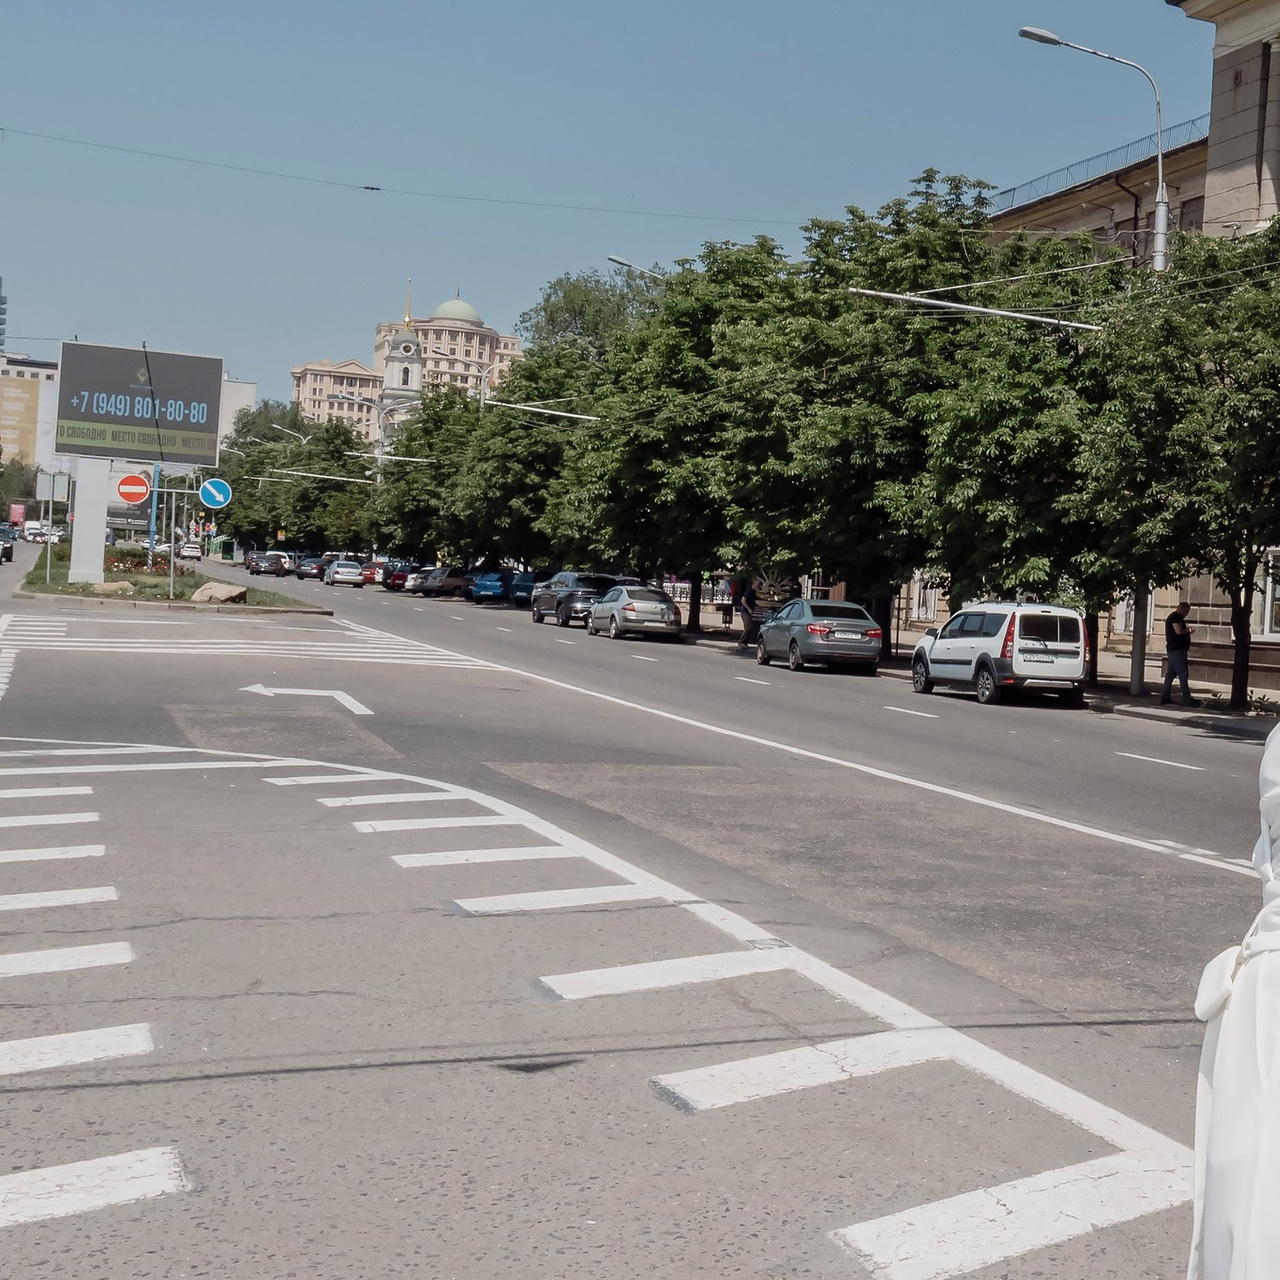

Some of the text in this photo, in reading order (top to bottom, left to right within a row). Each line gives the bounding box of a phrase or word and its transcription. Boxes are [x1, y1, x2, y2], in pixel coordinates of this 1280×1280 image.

[70, 391, 207, 424] +7 (949) 801-80-80
[66, 426, 107, 441] СВОБОДНО
[111, 430, 136, 444] МЕСТО
[137, 432, 177, 447] СВОБОДНО
